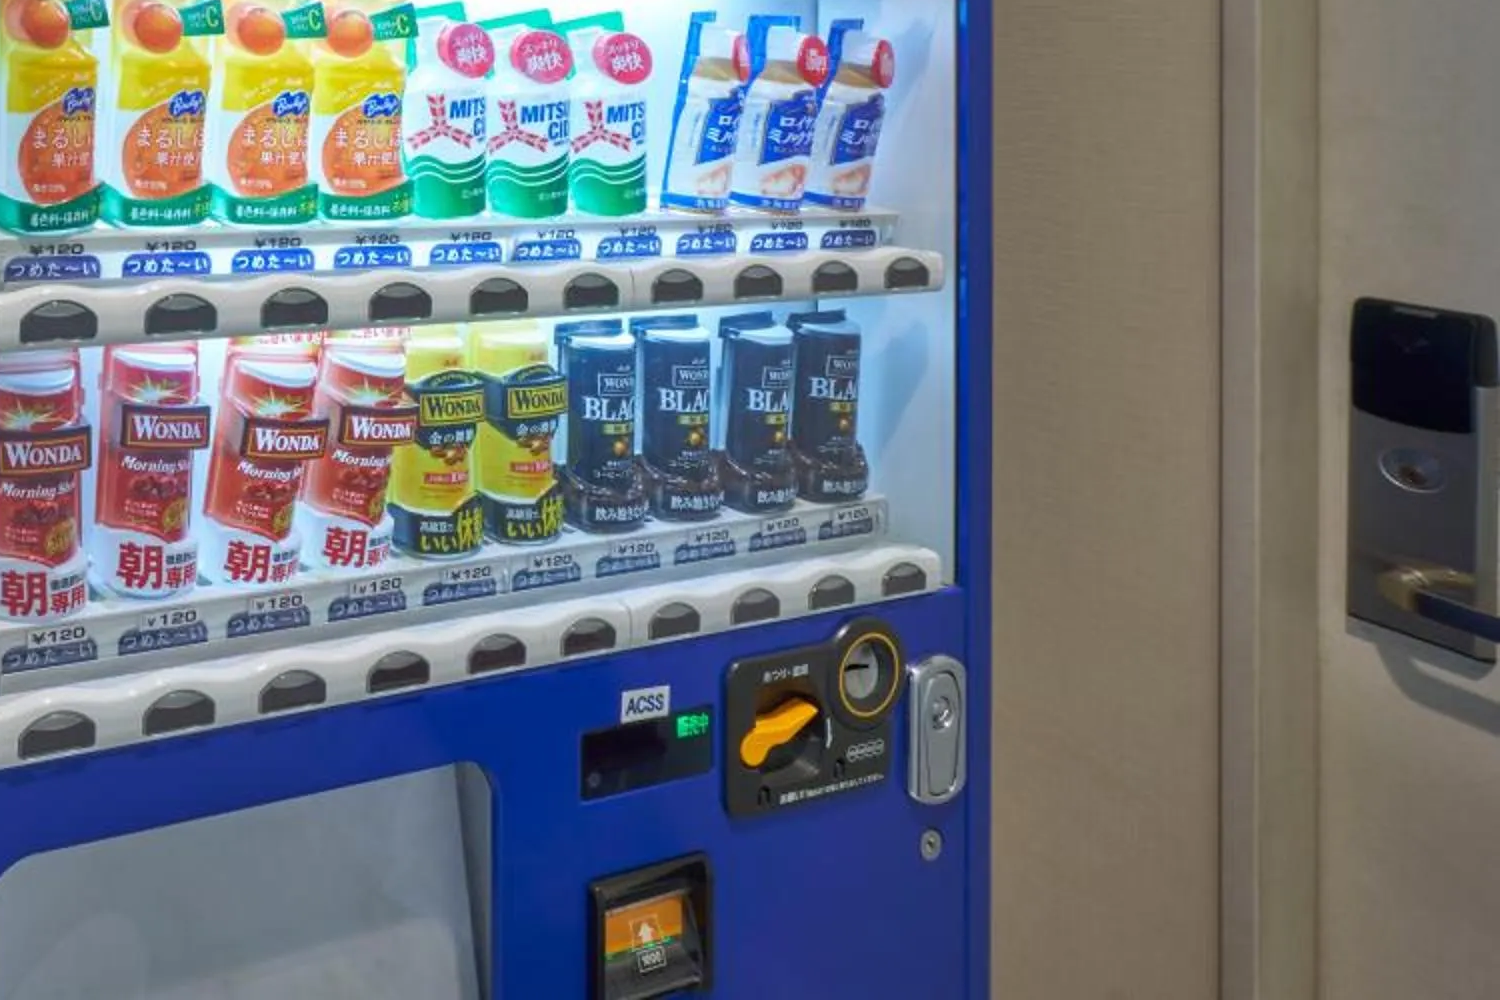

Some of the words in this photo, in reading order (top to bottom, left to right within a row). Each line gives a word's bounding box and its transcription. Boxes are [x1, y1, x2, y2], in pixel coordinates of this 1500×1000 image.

[29, 242, 85, 255] ¥120
[146, 240, 197, 252] ¥120
[132, 413, 203, 441] WONDA
[255, 427, 320, 452] WONDA
[3, 441, 82, 469] WONDA
[331, 449, 386, 468] Morning
[121, 455, 176, 475] Morning
[237, 460, 292, 482] Morning
[0, 481, 57, 501] Morning
[533, 554, 573, 569] ¥120
[450, 566, 492, 580] ¥120
[359, 577, 402, 594] ¥120
[256, 595, 303, 610] ¥120
[148, 609, 197, 626] ¥120
[31, 625, 86, 644] ¥120
[625, 692, 665, 716] ACSS
